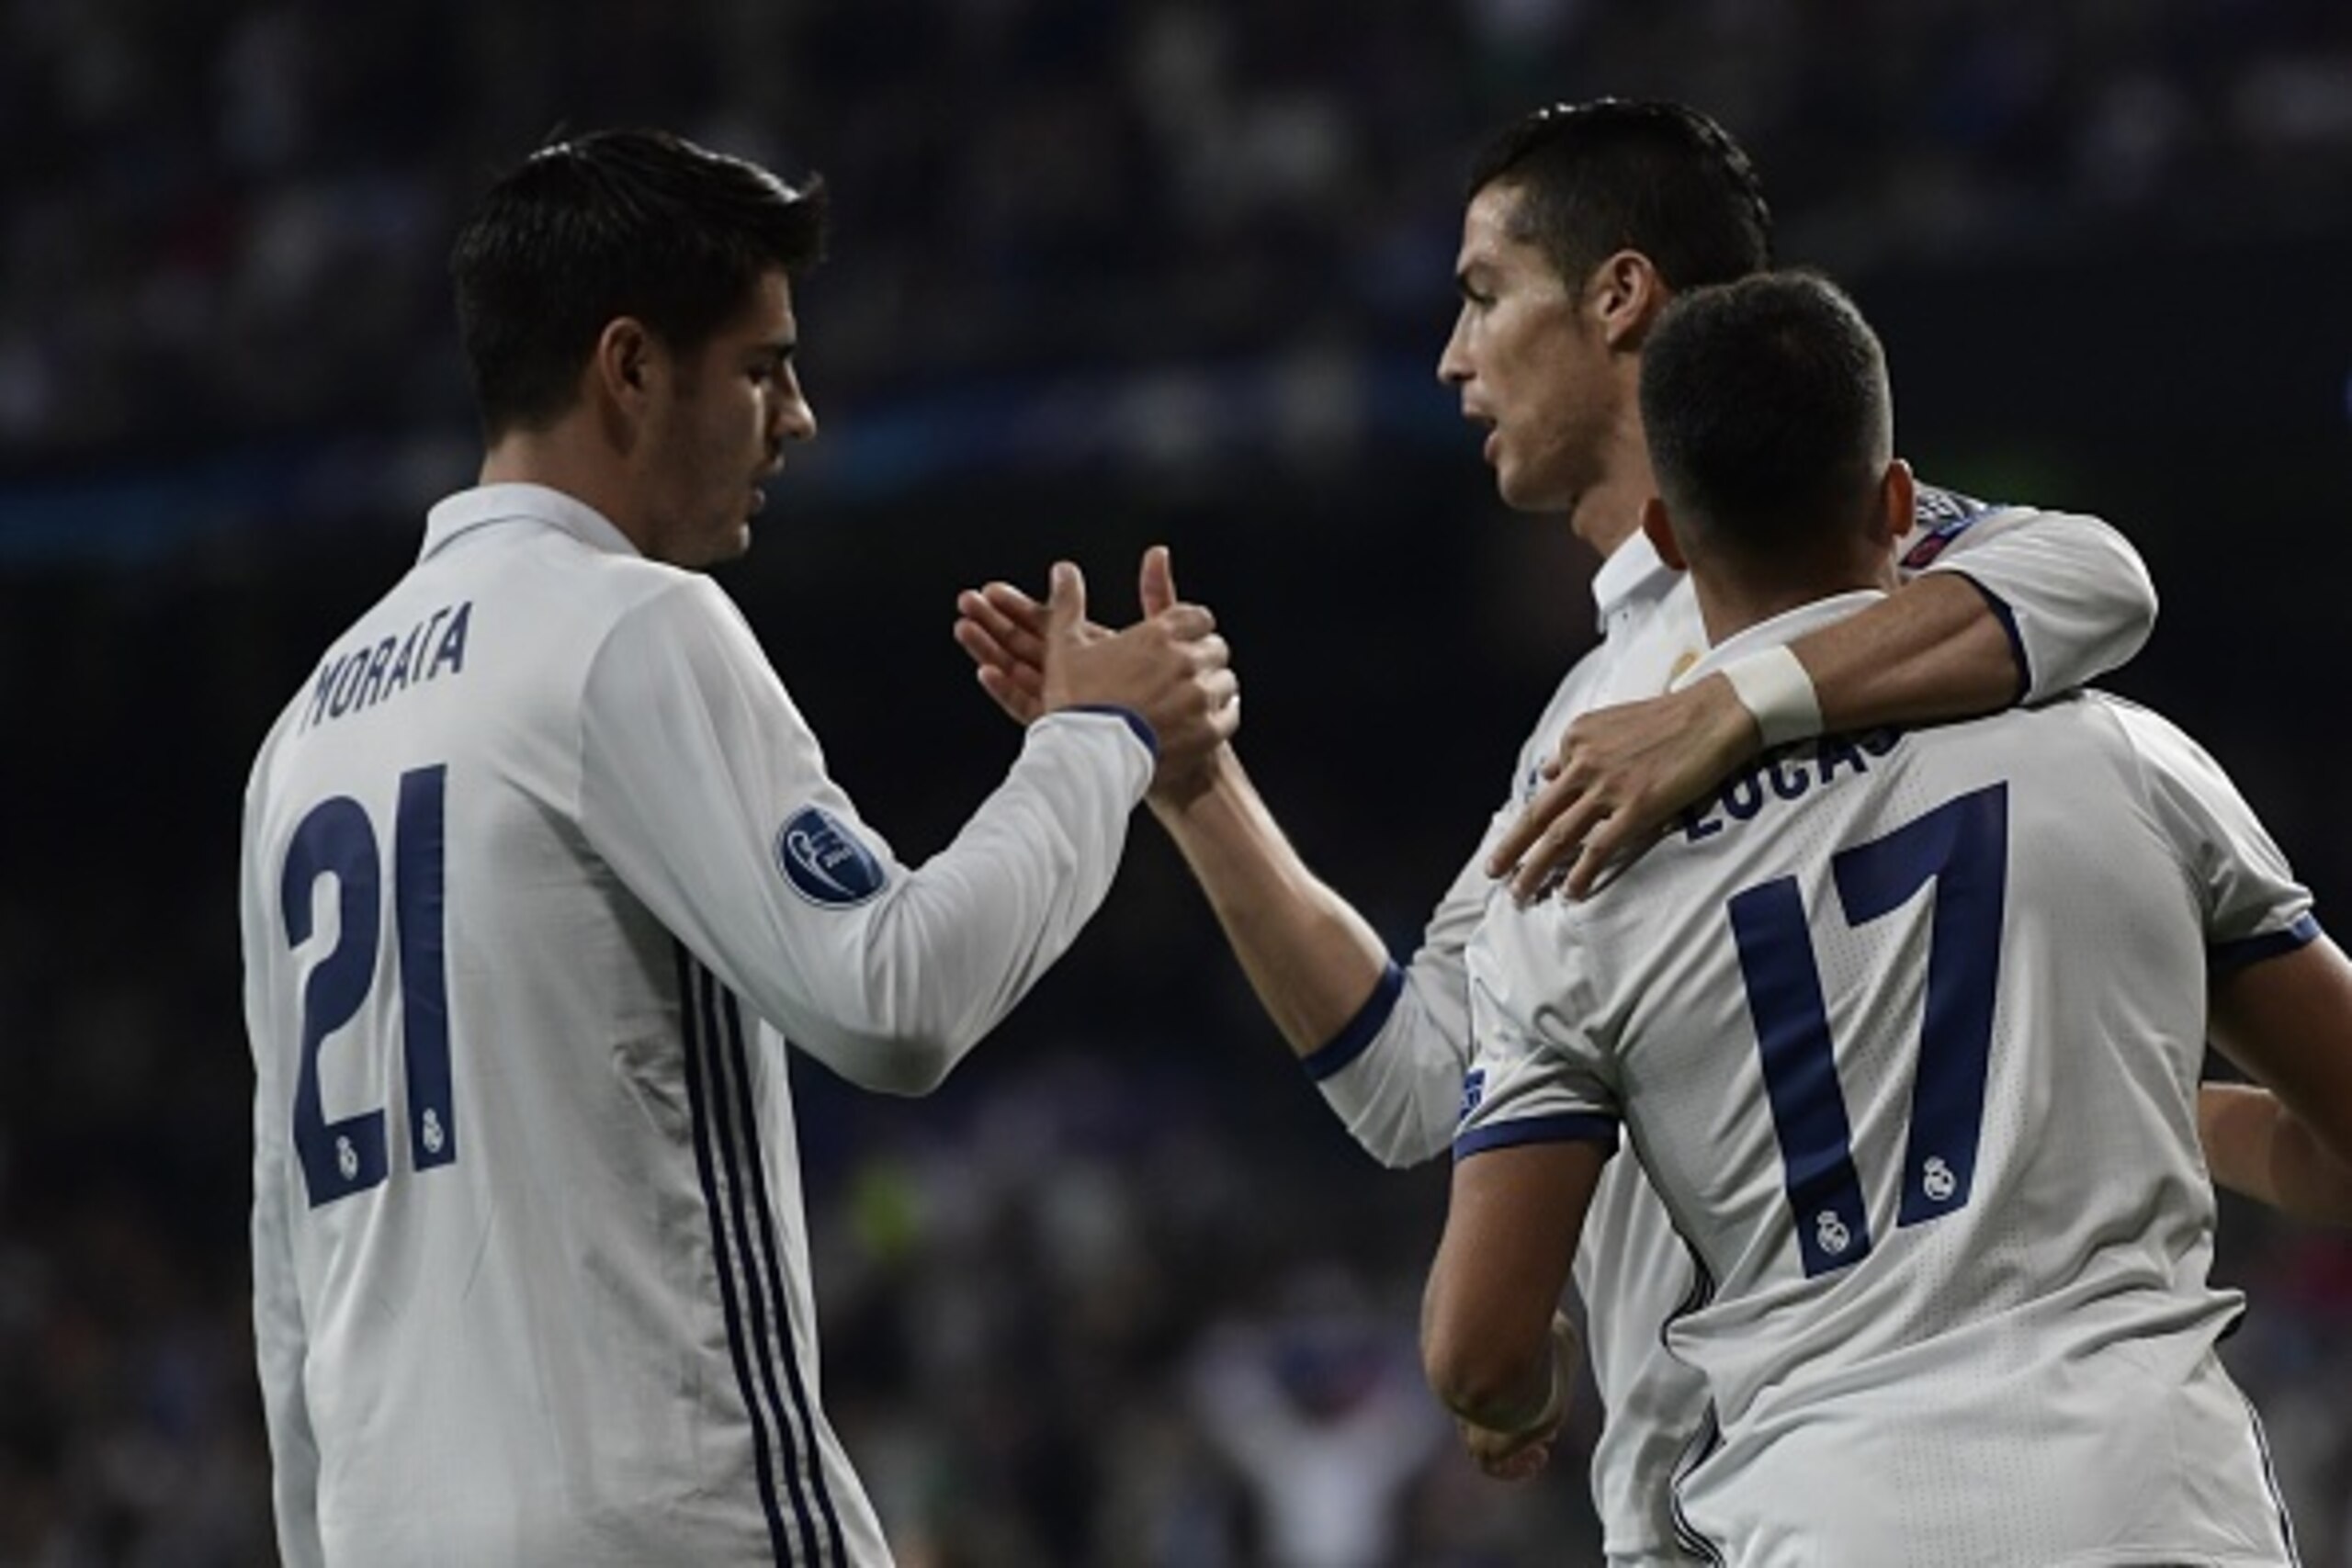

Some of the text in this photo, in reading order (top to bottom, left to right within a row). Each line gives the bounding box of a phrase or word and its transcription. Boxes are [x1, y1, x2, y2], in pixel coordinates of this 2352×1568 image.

[298, 601, 472, 737] MORATA
[281, 763, 456, 1209] 21
[1726, 781, 2008, 1279] 17
